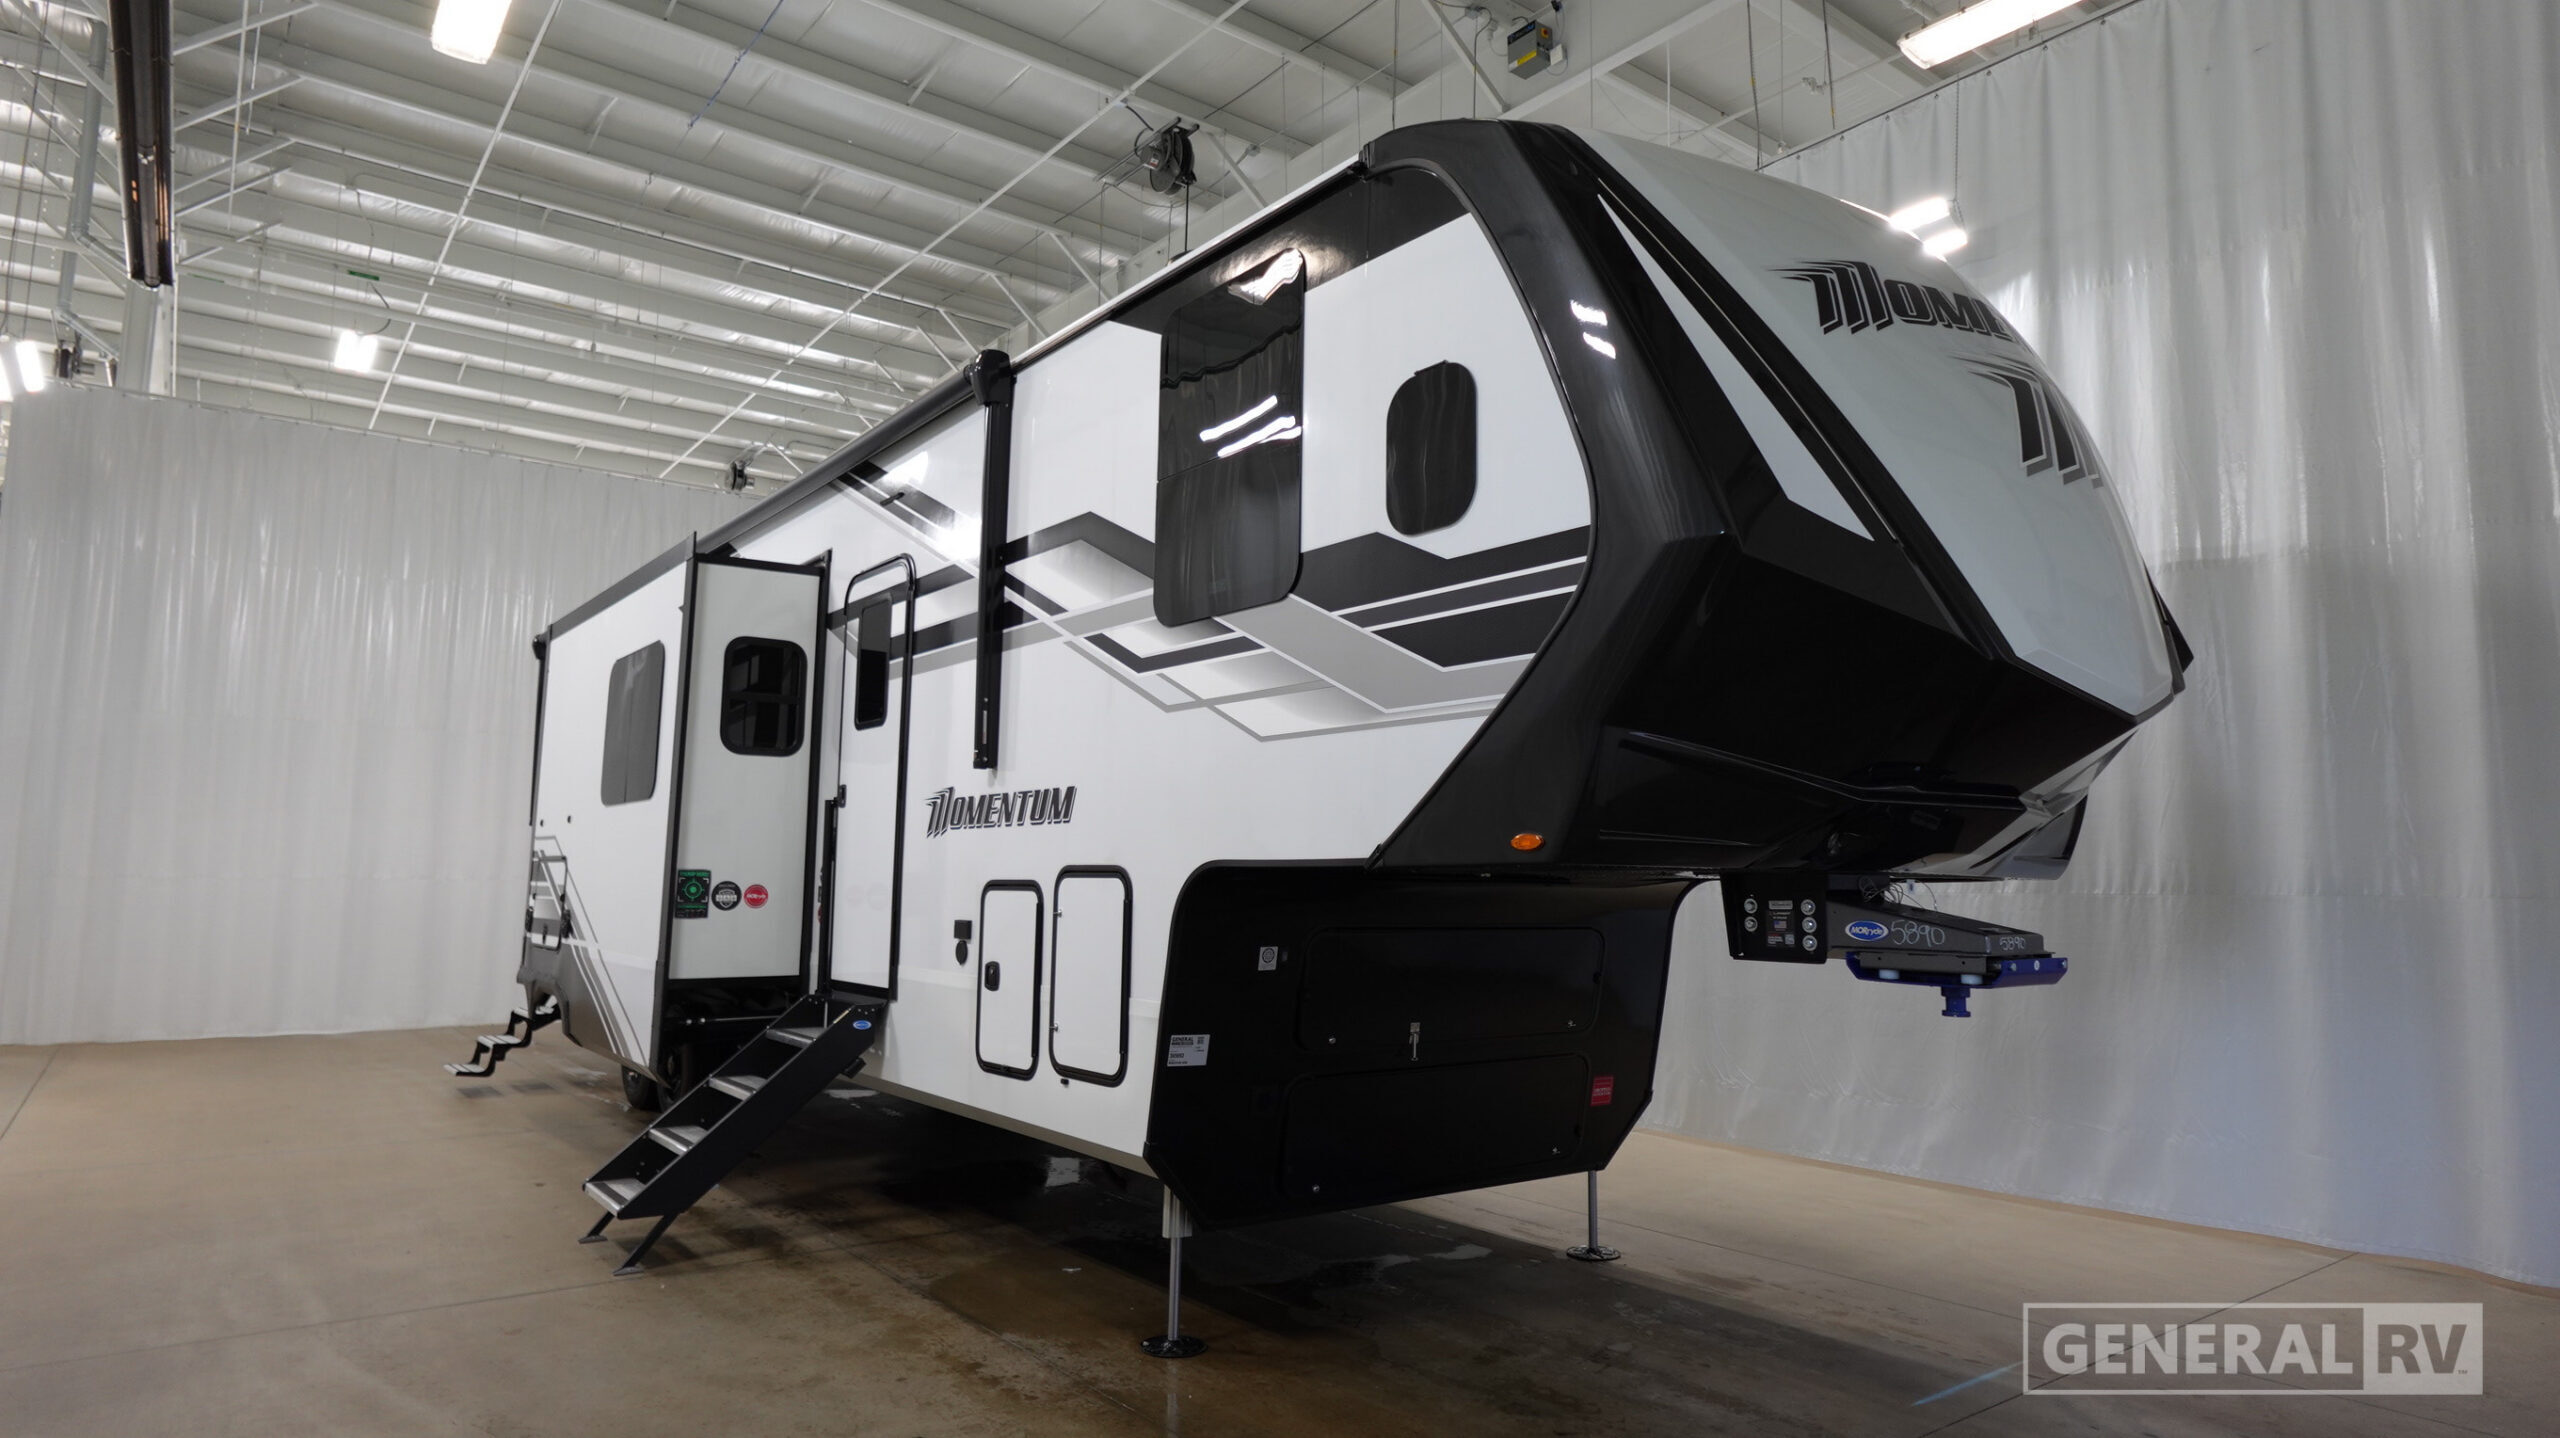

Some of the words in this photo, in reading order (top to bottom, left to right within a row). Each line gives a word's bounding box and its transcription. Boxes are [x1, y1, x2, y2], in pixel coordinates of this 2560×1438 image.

[924, 786, 1077, 838] MOMENTUM
[1891, 919, 1945, 947] 5890
[1999, 936, 2027, 951] 5890
